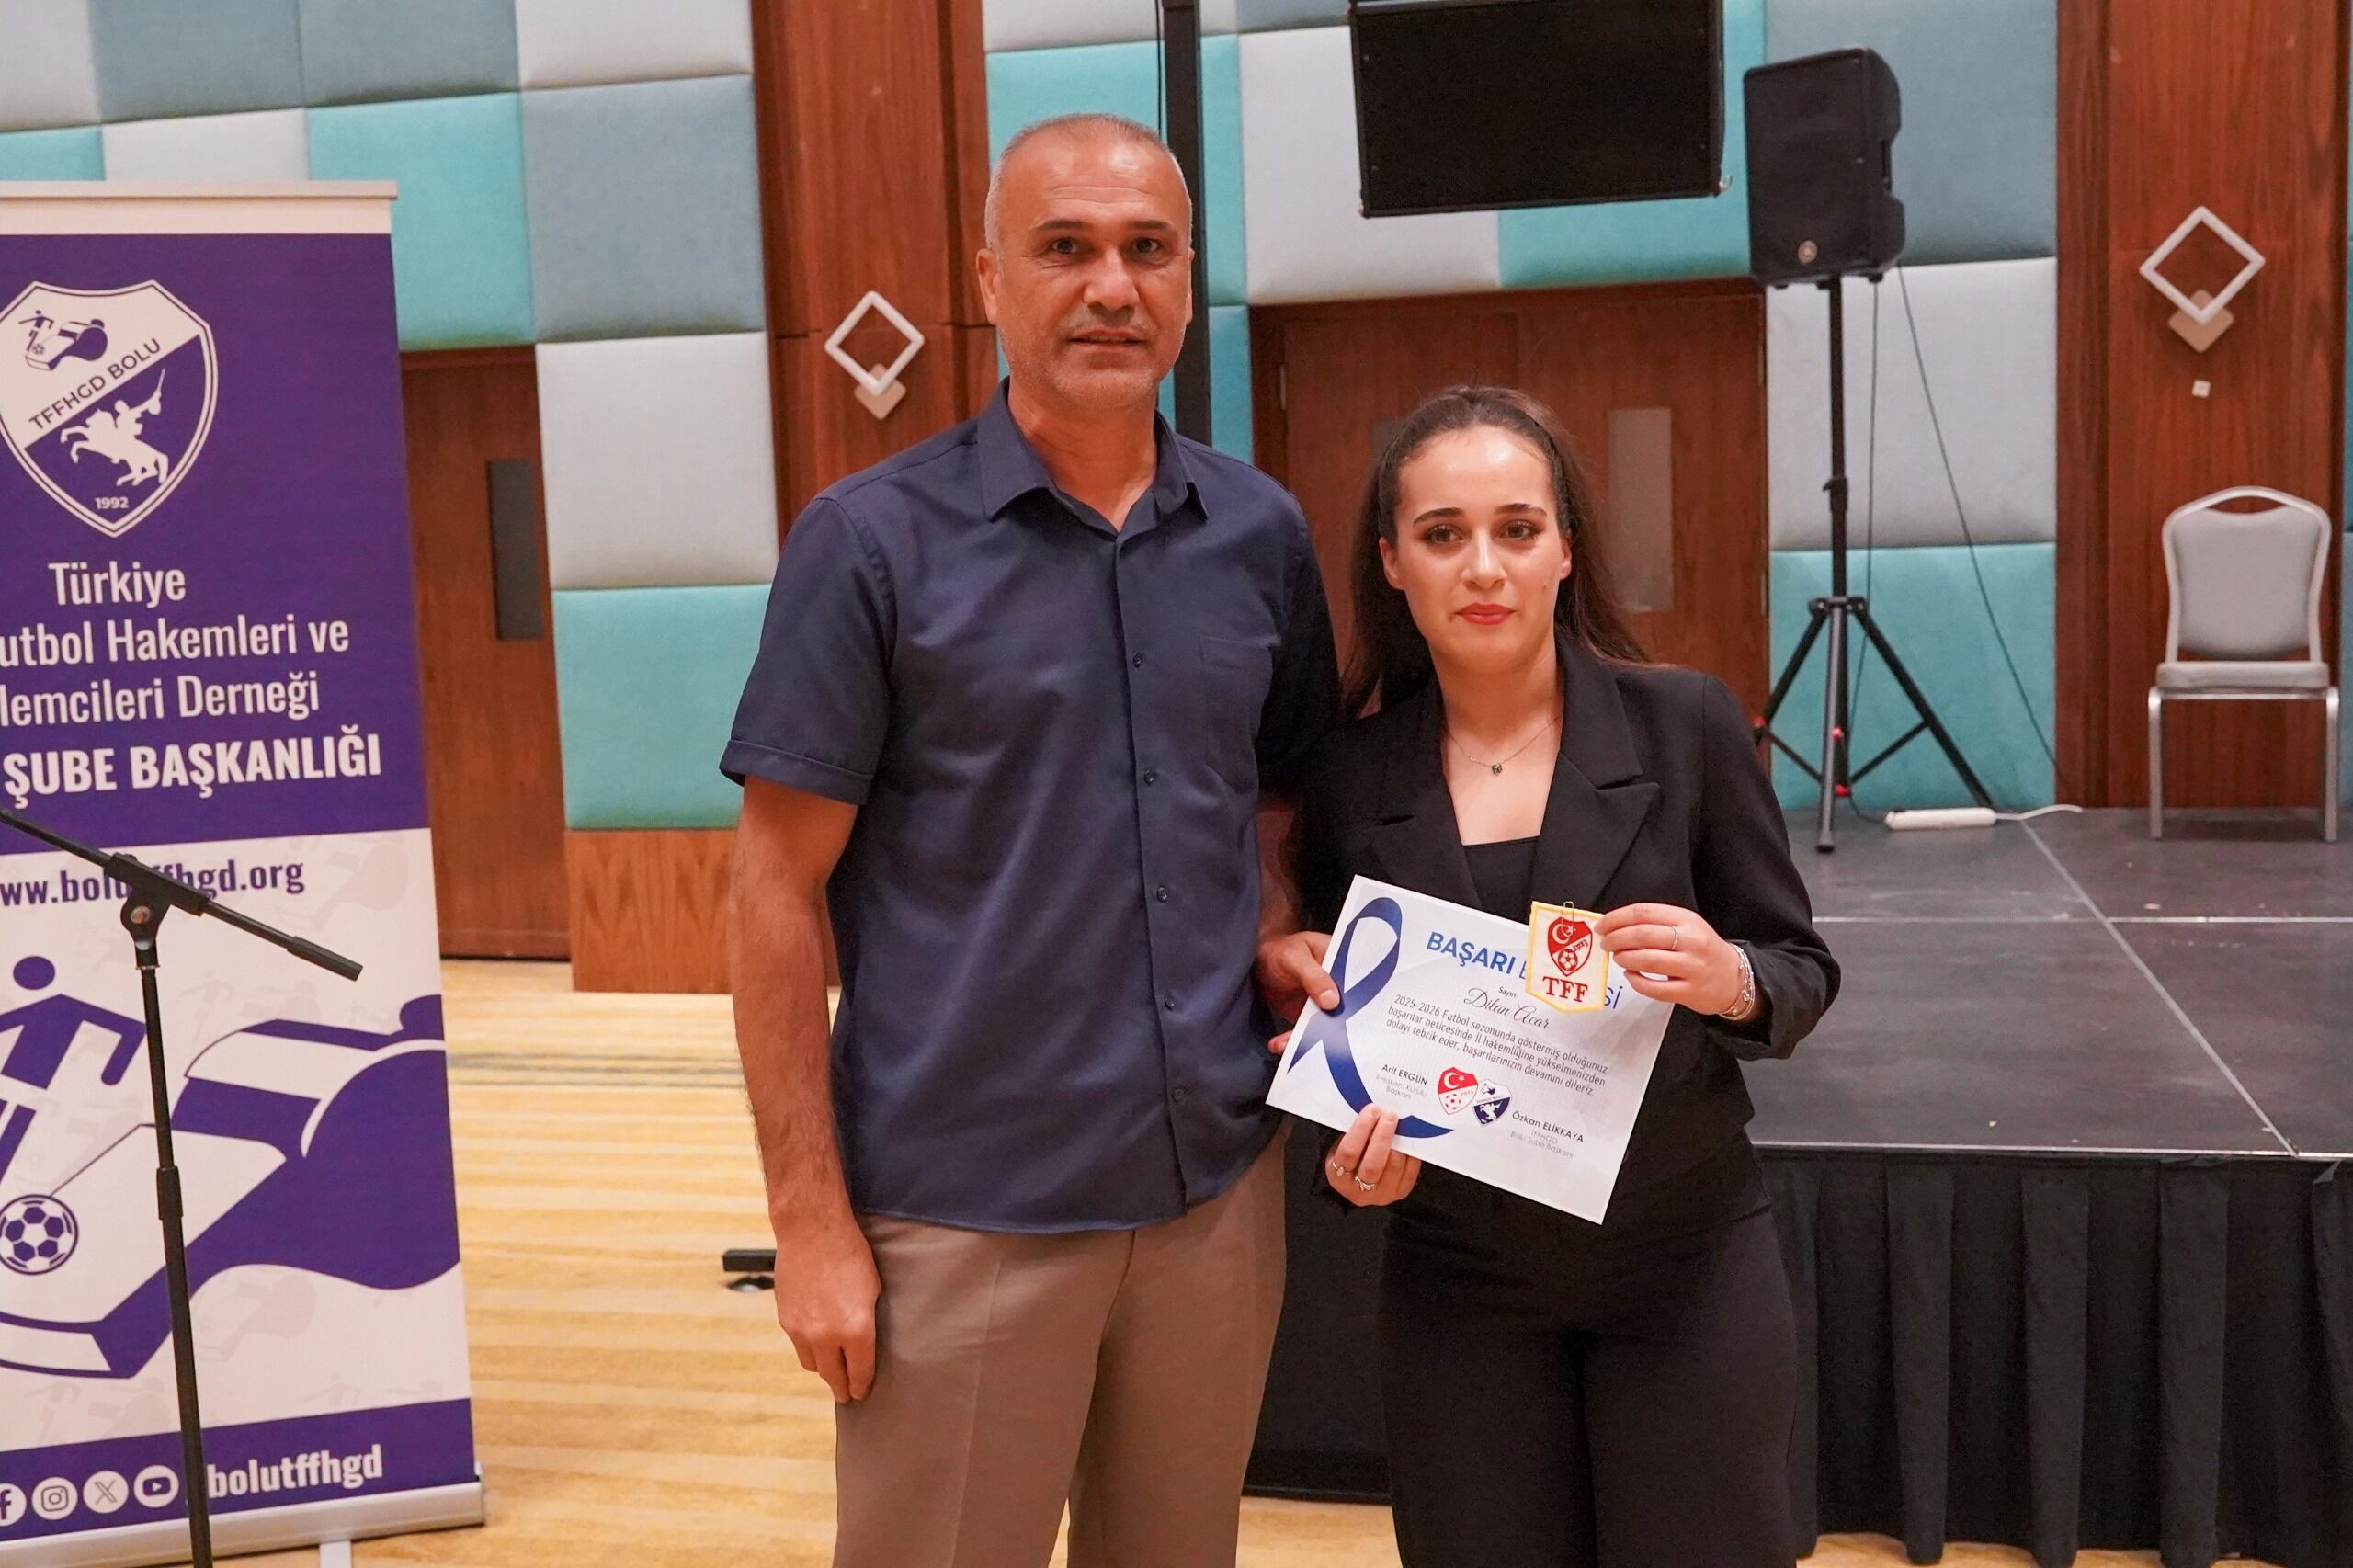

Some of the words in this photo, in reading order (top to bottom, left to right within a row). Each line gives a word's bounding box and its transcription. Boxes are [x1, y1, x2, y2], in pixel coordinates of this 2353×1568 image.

[28, 375, 106, 429] TFFHGD
[107, 338, 160, 379] BOLU
[95, 496, 129, 510] 1992
[48, 561, 186, 608] Türkiye
[107, 614, 297, 663] Hakemleri
[309, 619, 349, 653] ve
[177, 671, 320, 721] Derneği
[3, 748, 117, 809] ŞUBE
[130, 724, 381, 799] BAŞKANLIĞI
[1427, 931, 1516, 975] BAŞARI
[1463, 988, 1510, 1016] Dilan
[1513, 1002, 1550, 1029] Acar
[1542, 976, 1588, 1003] TFF
[1386, 1017, 1411, 1035] dolayı
[1413, 1027, 1436, 1041] tebrik
[1438, 1037, 1460, 1051] eder,
[1524, 1064, 1563, 1085] devamını
[1388, 1005, 1424, 1024] başarılar
[1425, 1019, 1473, 1041] neticesinde
[1483, 1037, 1534, 1062] hakemliğine
[1537, 1057, 1606, 1086] yükselmenizden
[1394, 994, 1440, 1017] 2025-2026
[1442, 1009, 1471, 1027] Futbol
[1471, 1021, 1516, 1042] sezonunda
[1518, 1037, 1561, 1060] göstermiş
[1563, 1051, 1608, 1074] olduğunuz
[1382, 1064, 1397, 1074] Arif
[1398, 1069, 1428, 1086] ERGÜN
[1512, 1109, 1541, 1127] Özkan
[1542, 1121, 1584, 1142] ELİKKAYA
[207, 1444, 382, 1499] bolutffhgd
